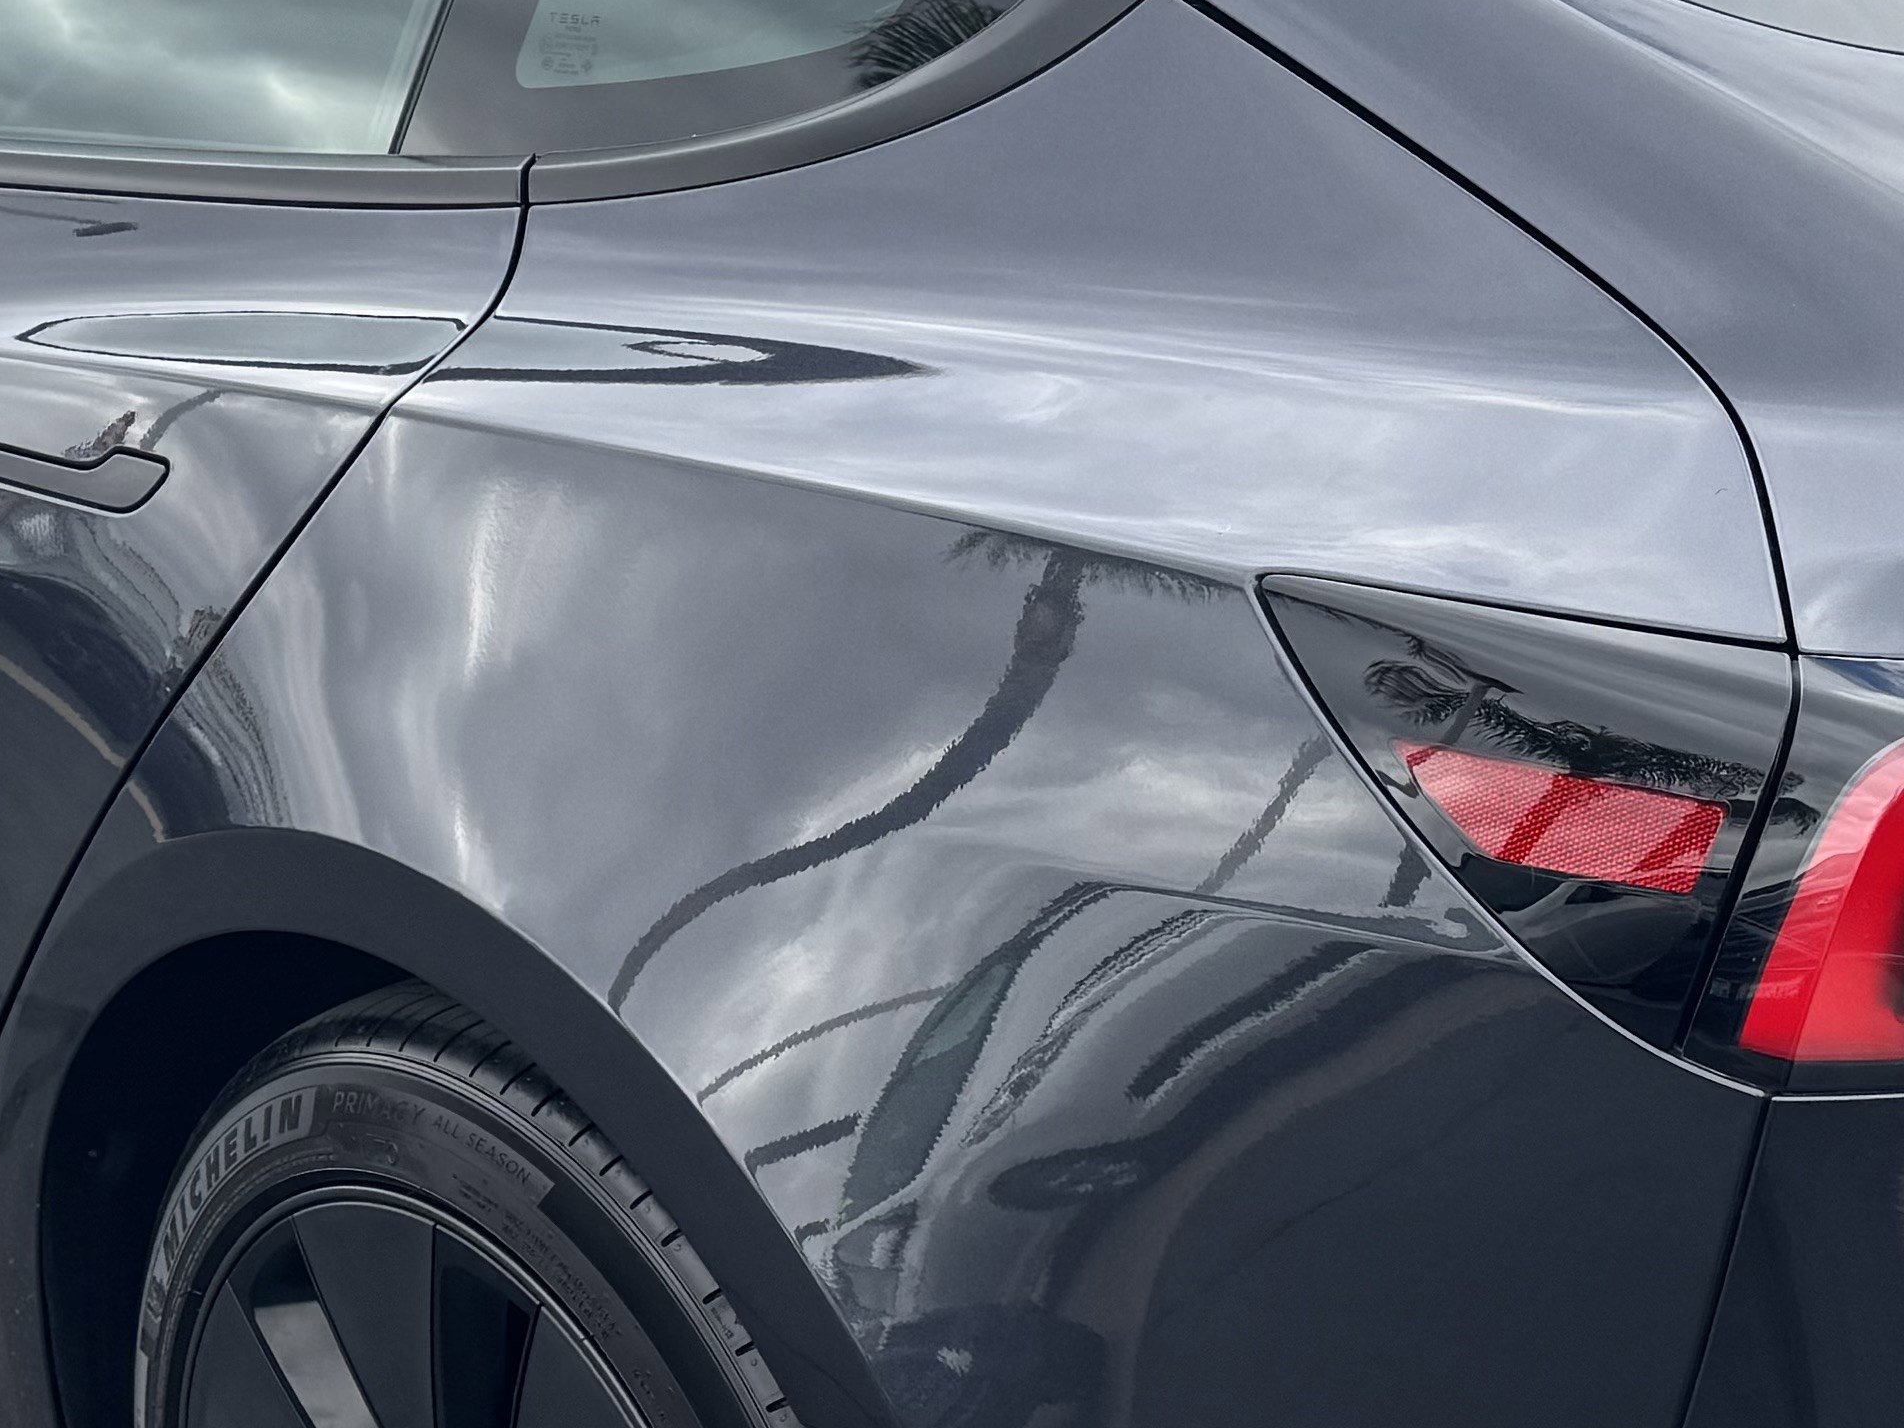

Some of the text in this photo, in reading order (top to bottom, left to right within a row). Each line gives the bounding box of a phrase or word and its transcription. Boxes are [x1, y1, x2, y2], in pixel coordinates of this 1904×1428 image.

[549, 12, 601, 27] TESLA
[162, 1093, 304, 1272] MICHELIN
[331, 1090, 531, 1186] PRIMACY ALL SEASON
